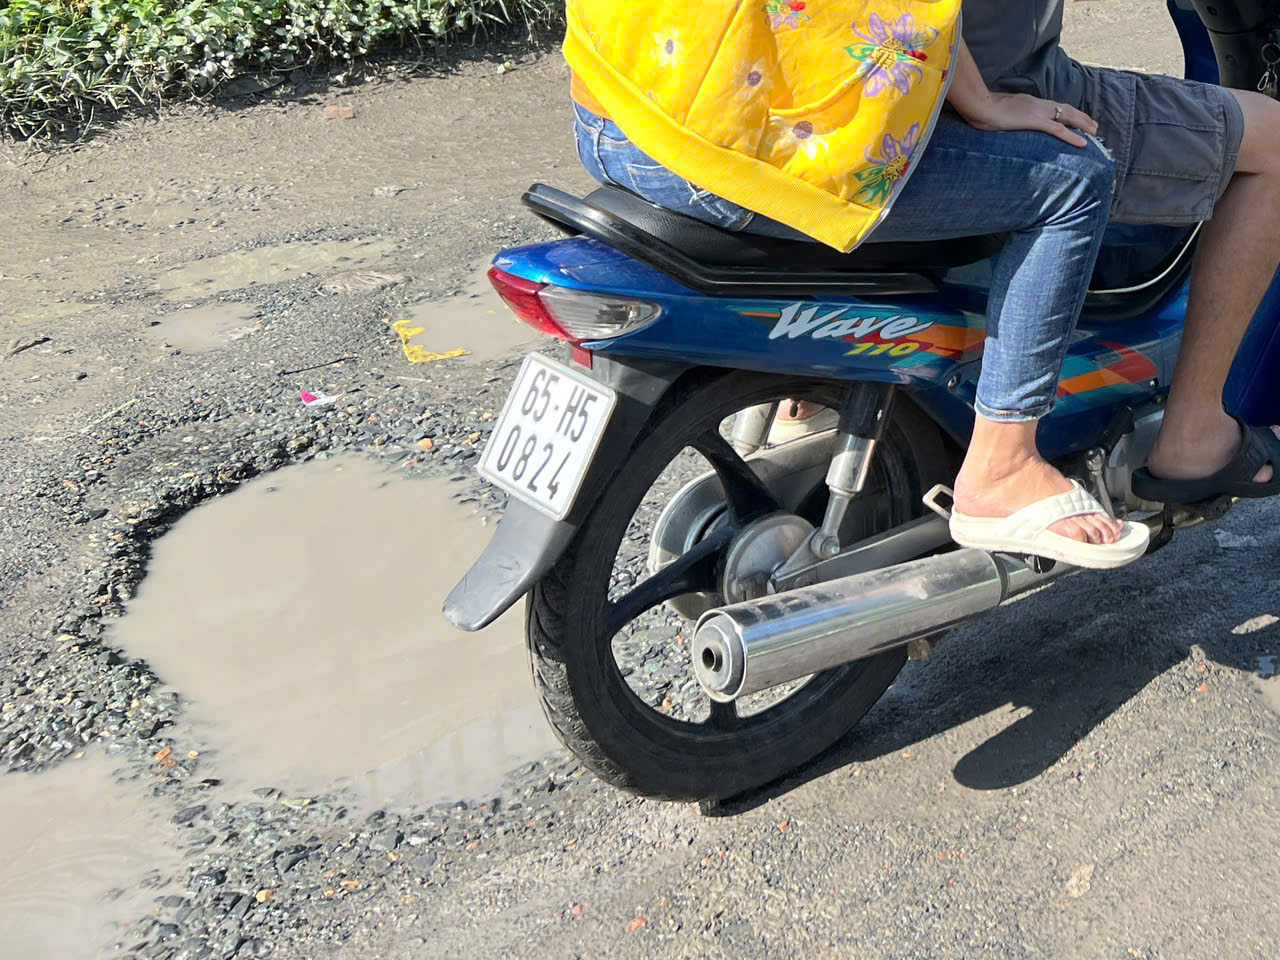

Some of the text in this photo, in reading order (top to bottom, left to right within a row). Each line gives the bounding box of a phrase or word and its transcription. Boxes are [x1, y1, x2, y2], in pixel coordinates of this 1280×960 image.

[768, 301, 934, 340] Wave
[845, 342, 920, 357] 110
[496, 424, 571, 500] 0824
